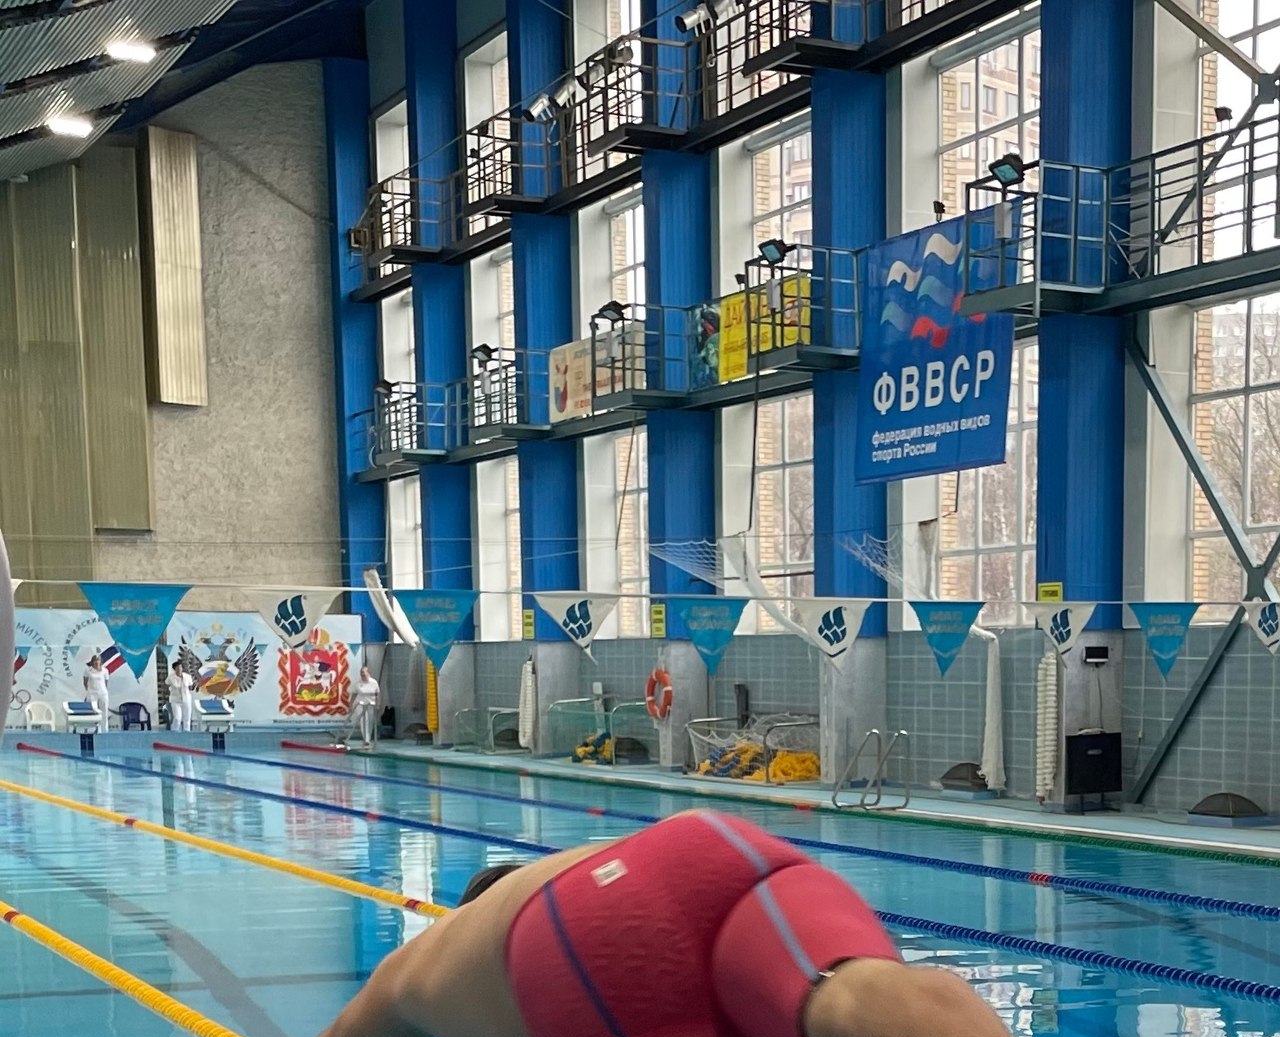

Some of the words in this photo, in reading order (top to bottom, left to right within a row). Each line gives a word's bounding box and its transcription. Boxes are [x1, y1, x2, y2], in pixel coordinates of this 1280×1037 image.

[873, 350, 995, 415] ФВВСР
[872, 427, 923, 448] федерация
[923, 420, 959, 437] водных
[960, 415, 991, 431] видов
[872, 447, 902, 464] спорта
[903, 442, 937, 457] России
